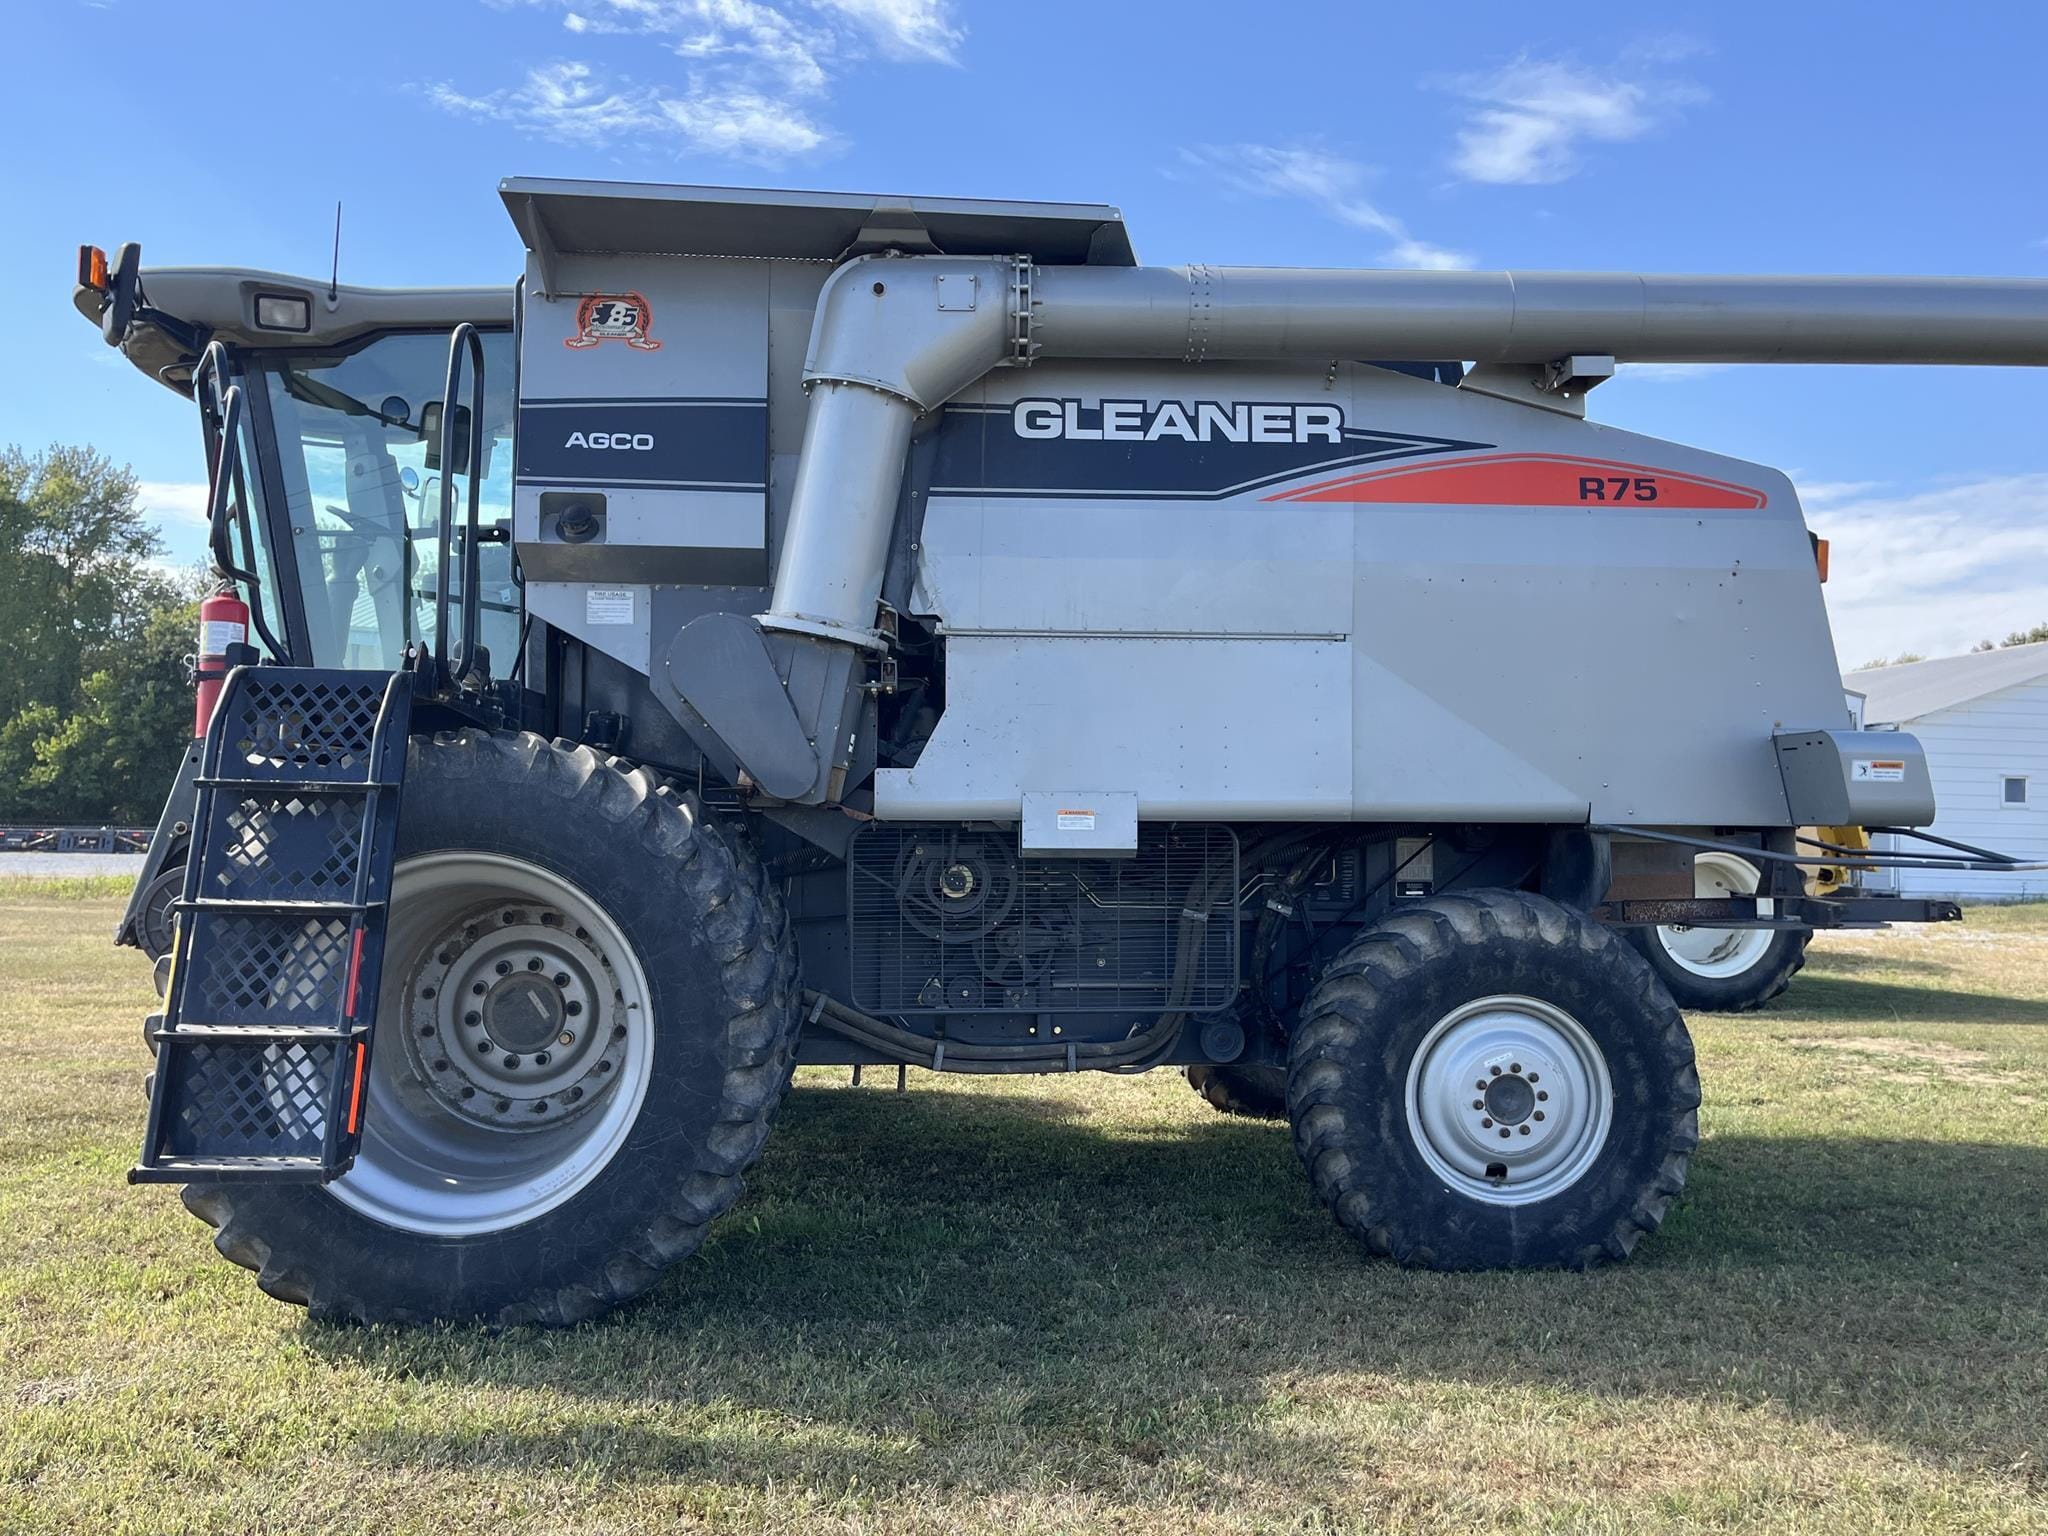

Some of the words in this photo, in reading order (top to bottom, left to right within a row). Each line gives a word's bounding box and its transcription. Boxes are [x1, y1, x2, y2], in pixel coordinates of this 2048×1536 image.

[609, 307, 638, 326] 85
[1013, 400, 1342, 443] GLEANER
[564, 431, 654, 450] AGCO
[1579, 477, 1658, 501] R75
